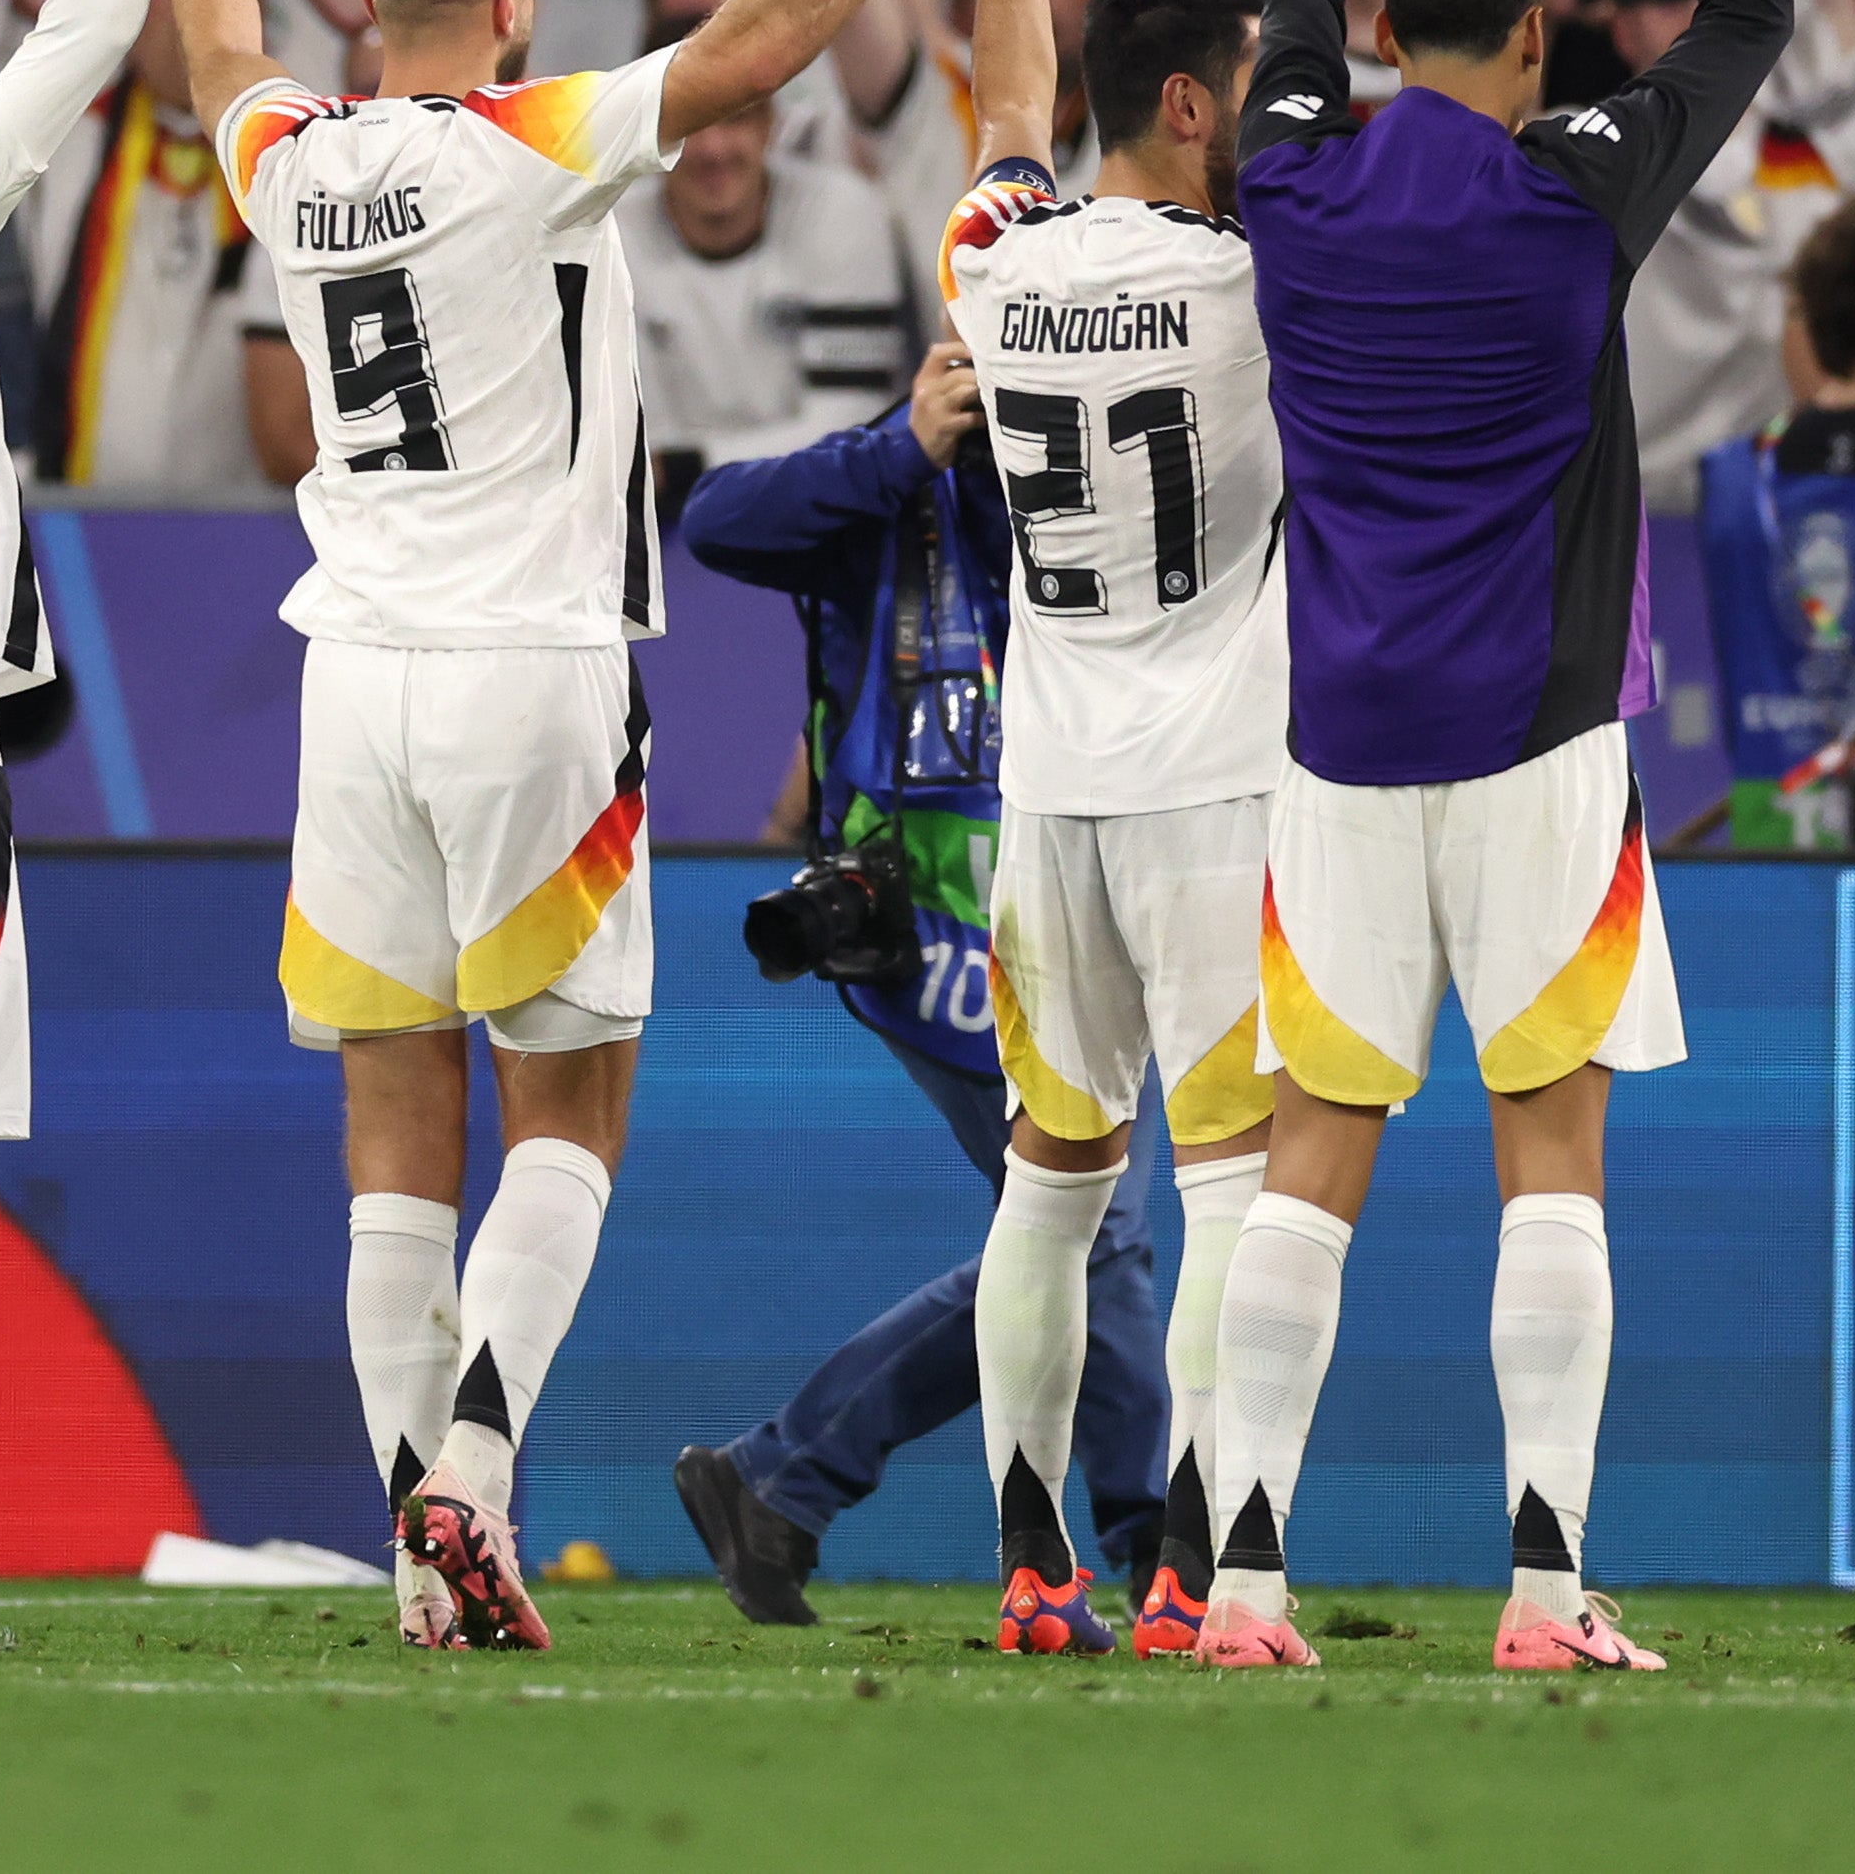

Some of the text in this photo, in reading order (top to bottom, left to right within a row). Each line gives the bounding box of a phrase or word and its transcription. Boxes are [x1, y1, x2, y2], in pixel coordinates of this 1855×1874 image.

[320, 267, 458, 473] 9
[1000, 292, 1189, 354] GÜNDOĞAN
[995, 387, 1207, 618] 21
